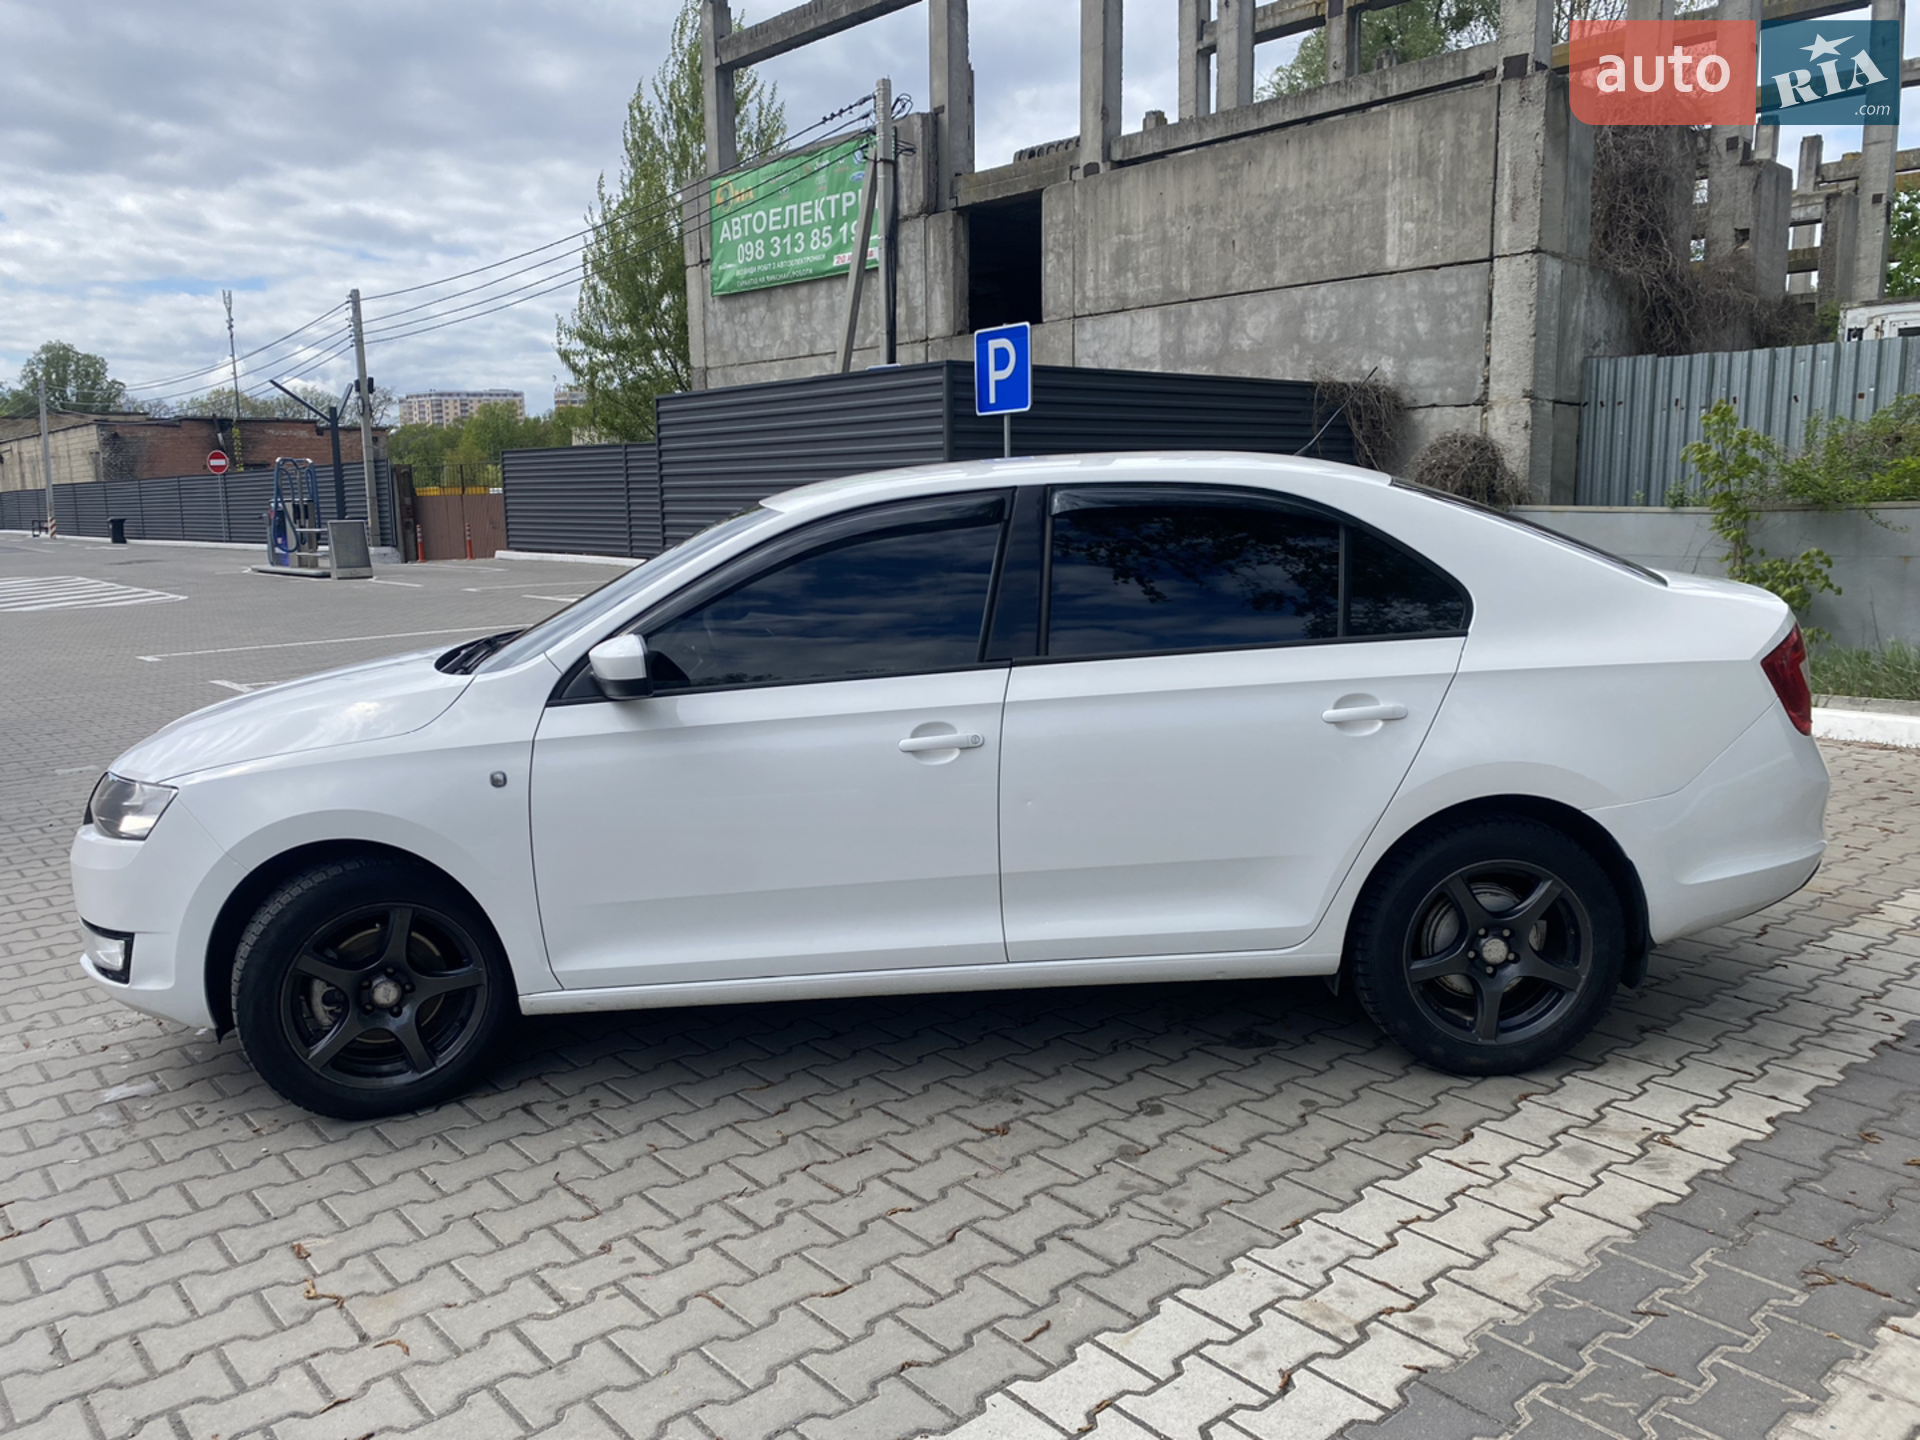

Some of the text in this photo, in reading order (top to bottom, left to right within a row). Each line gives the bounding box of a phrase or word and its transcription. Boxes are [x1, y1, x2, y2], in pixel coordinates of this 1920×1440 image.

[737, 239, 765, 265] 098
[770, 232, 805, 260] 313
[810, 226, 833, 251] 85
[987, 337, 1016, 404] P
